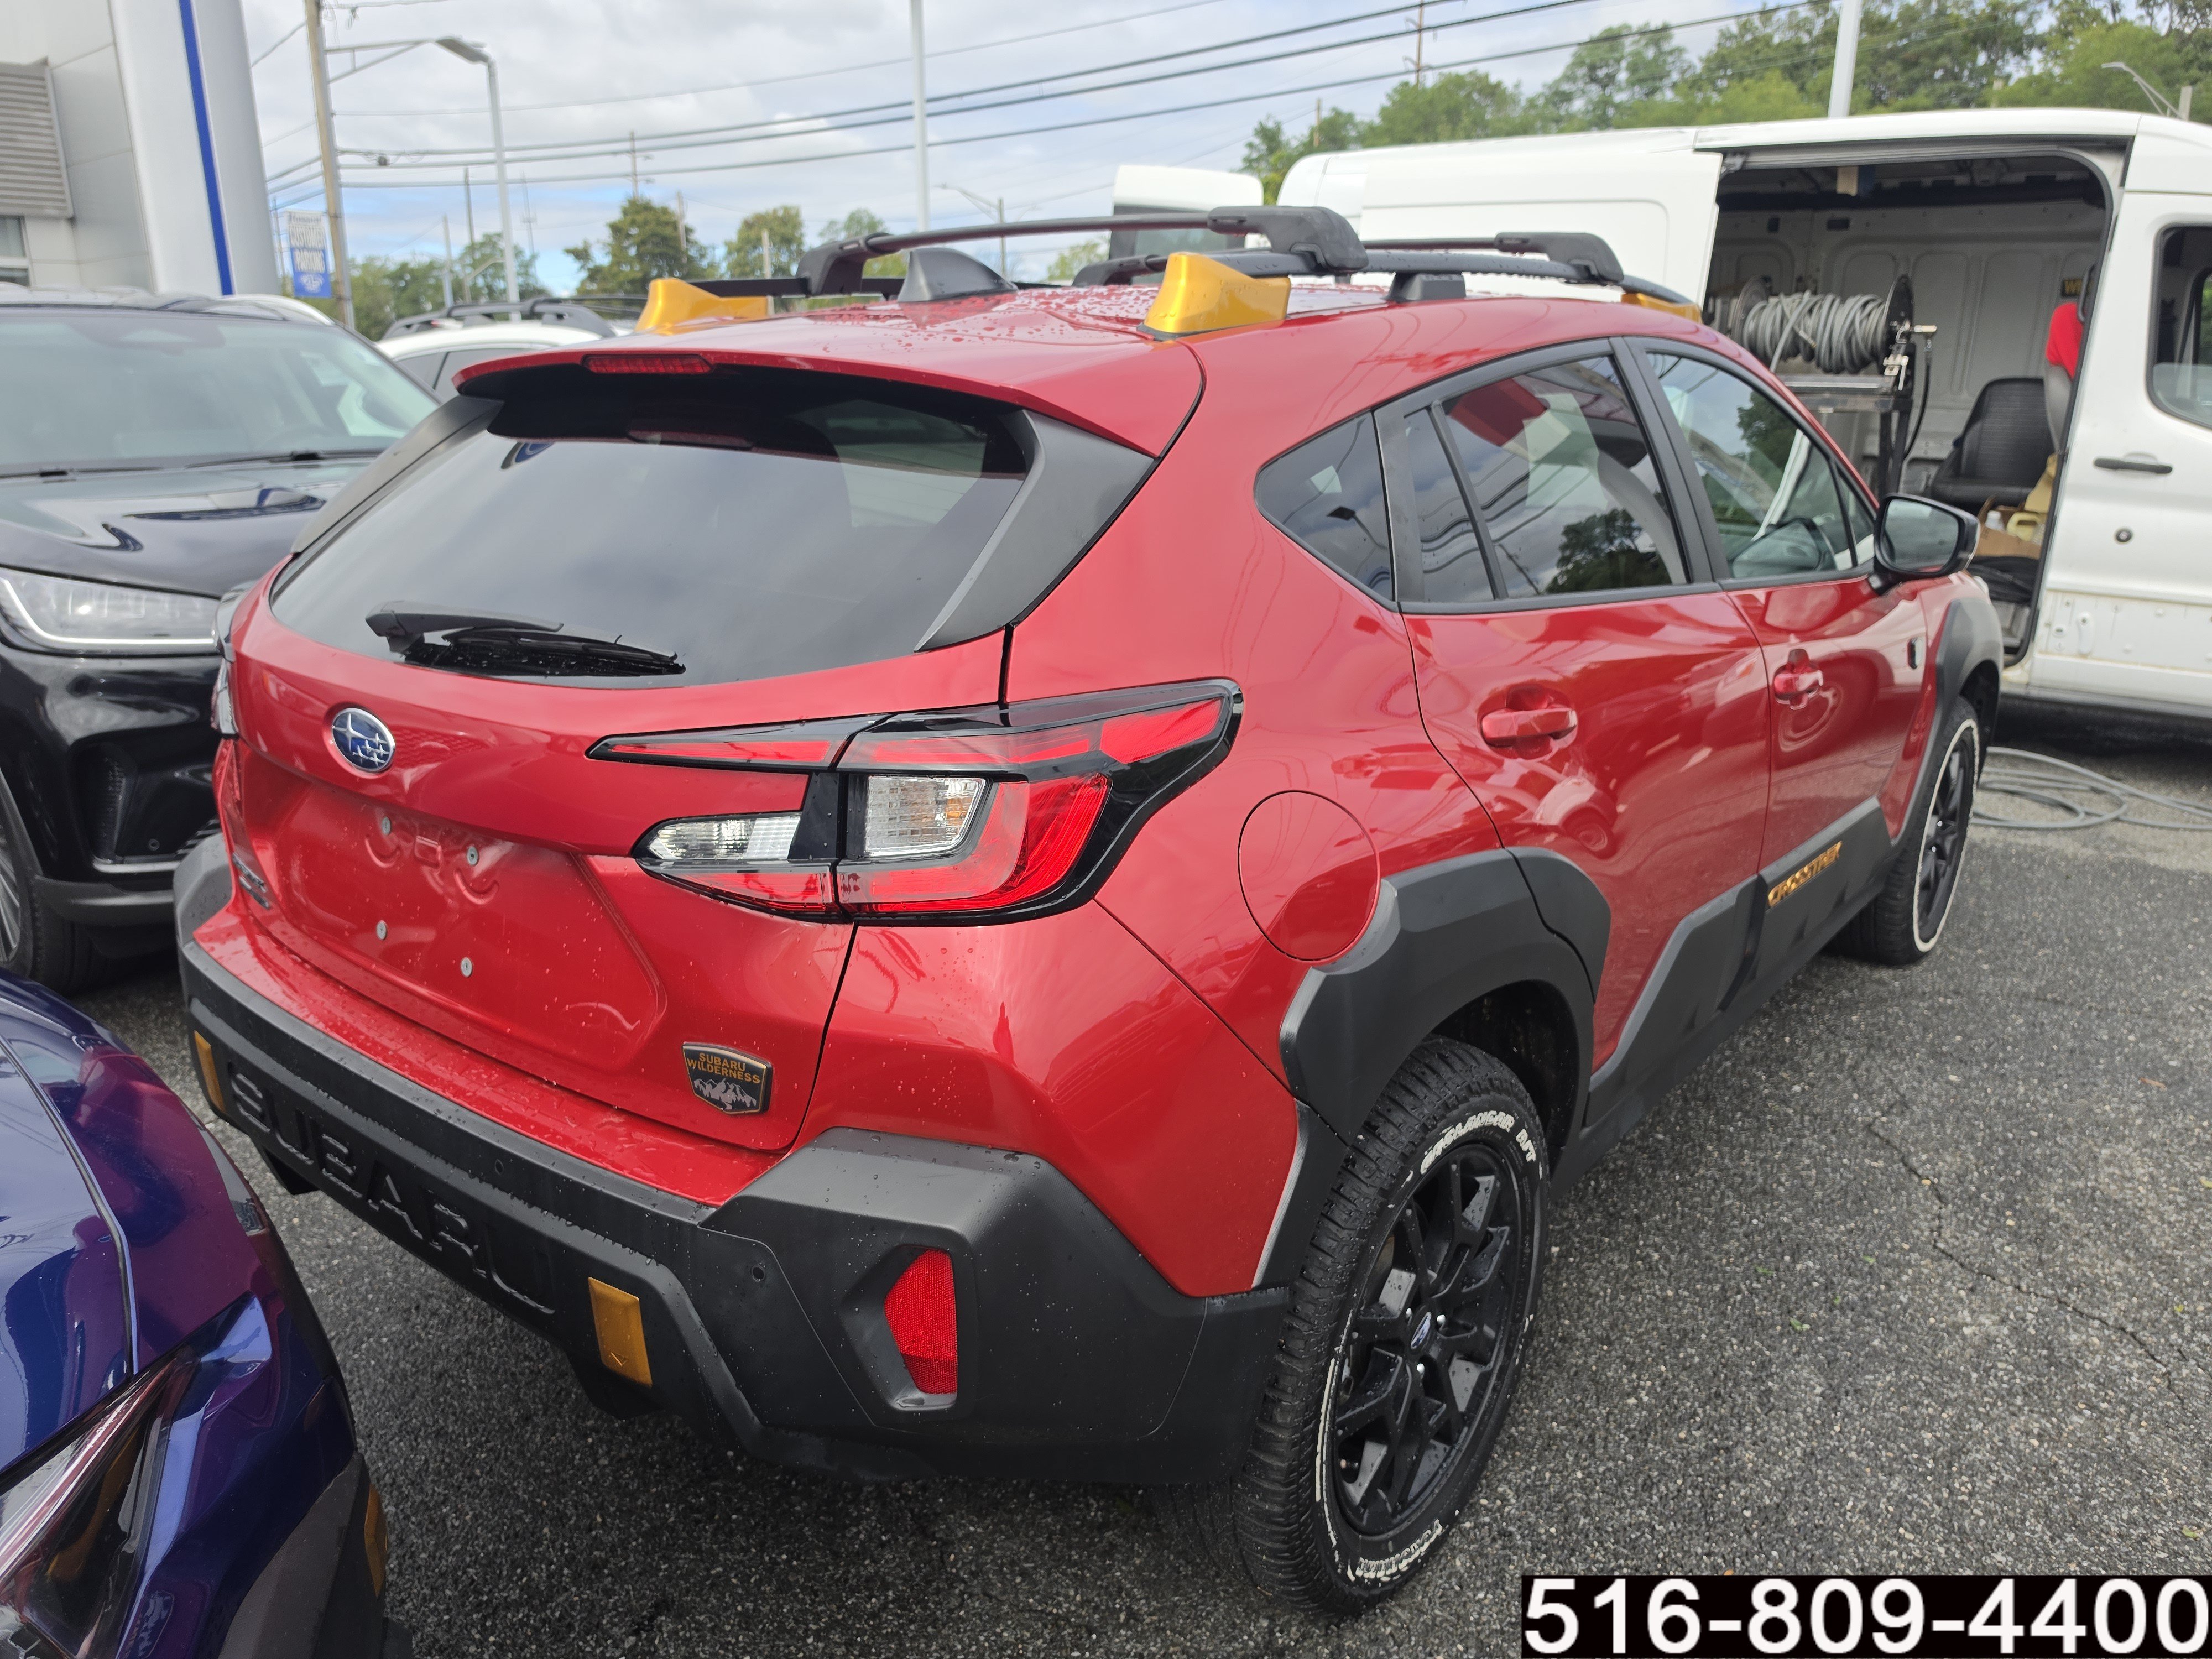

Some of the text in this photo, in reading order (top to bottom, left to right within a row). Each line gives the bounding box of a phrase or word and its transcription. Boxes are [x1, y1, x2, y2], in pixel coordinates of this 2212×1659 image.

[687, 1057, 761, 1084] WILDERNESS
[698, 1052, 745, 1072] SUBARU
[228, 1059, 556, 1315] SUBARU
